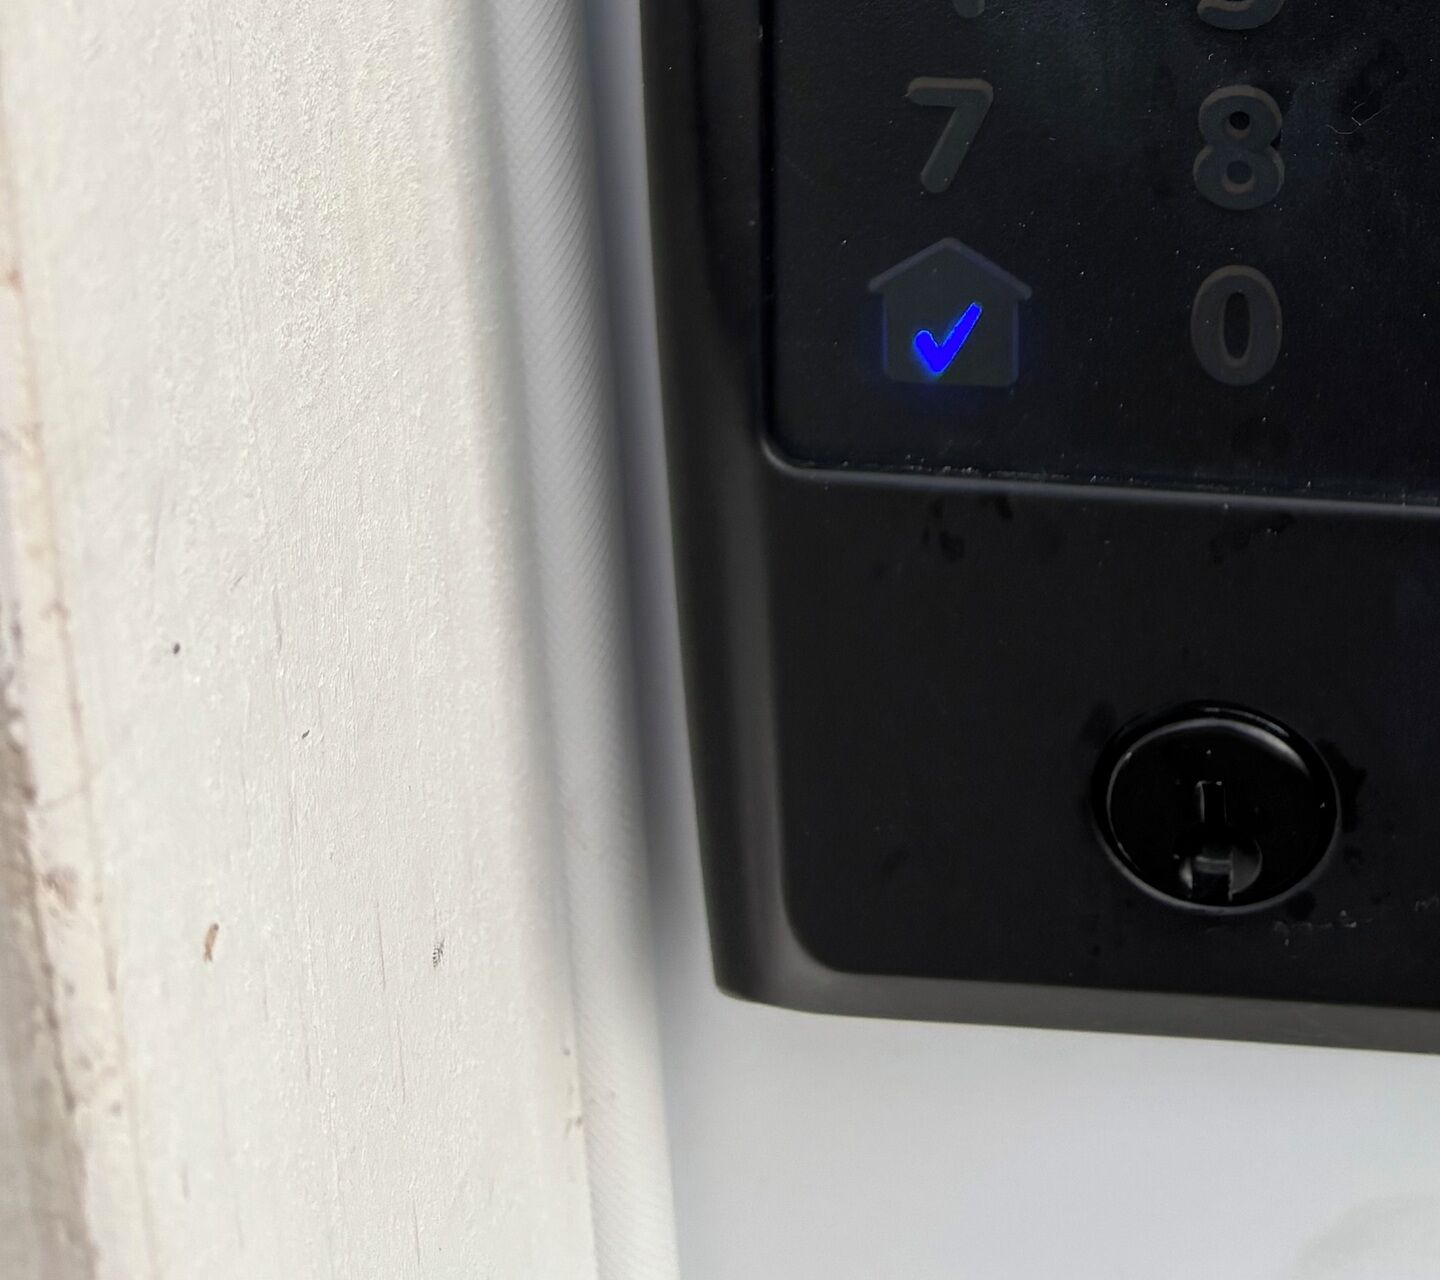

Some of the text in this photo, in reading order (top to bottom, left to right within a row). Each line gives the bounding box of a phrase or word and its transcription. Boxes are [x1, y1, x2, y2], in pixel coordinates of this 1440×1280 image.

[905, 76, 994, 194] 7
[1192, 83, 1286, 211] 8
[1190, 264, 1283, 386] 0
